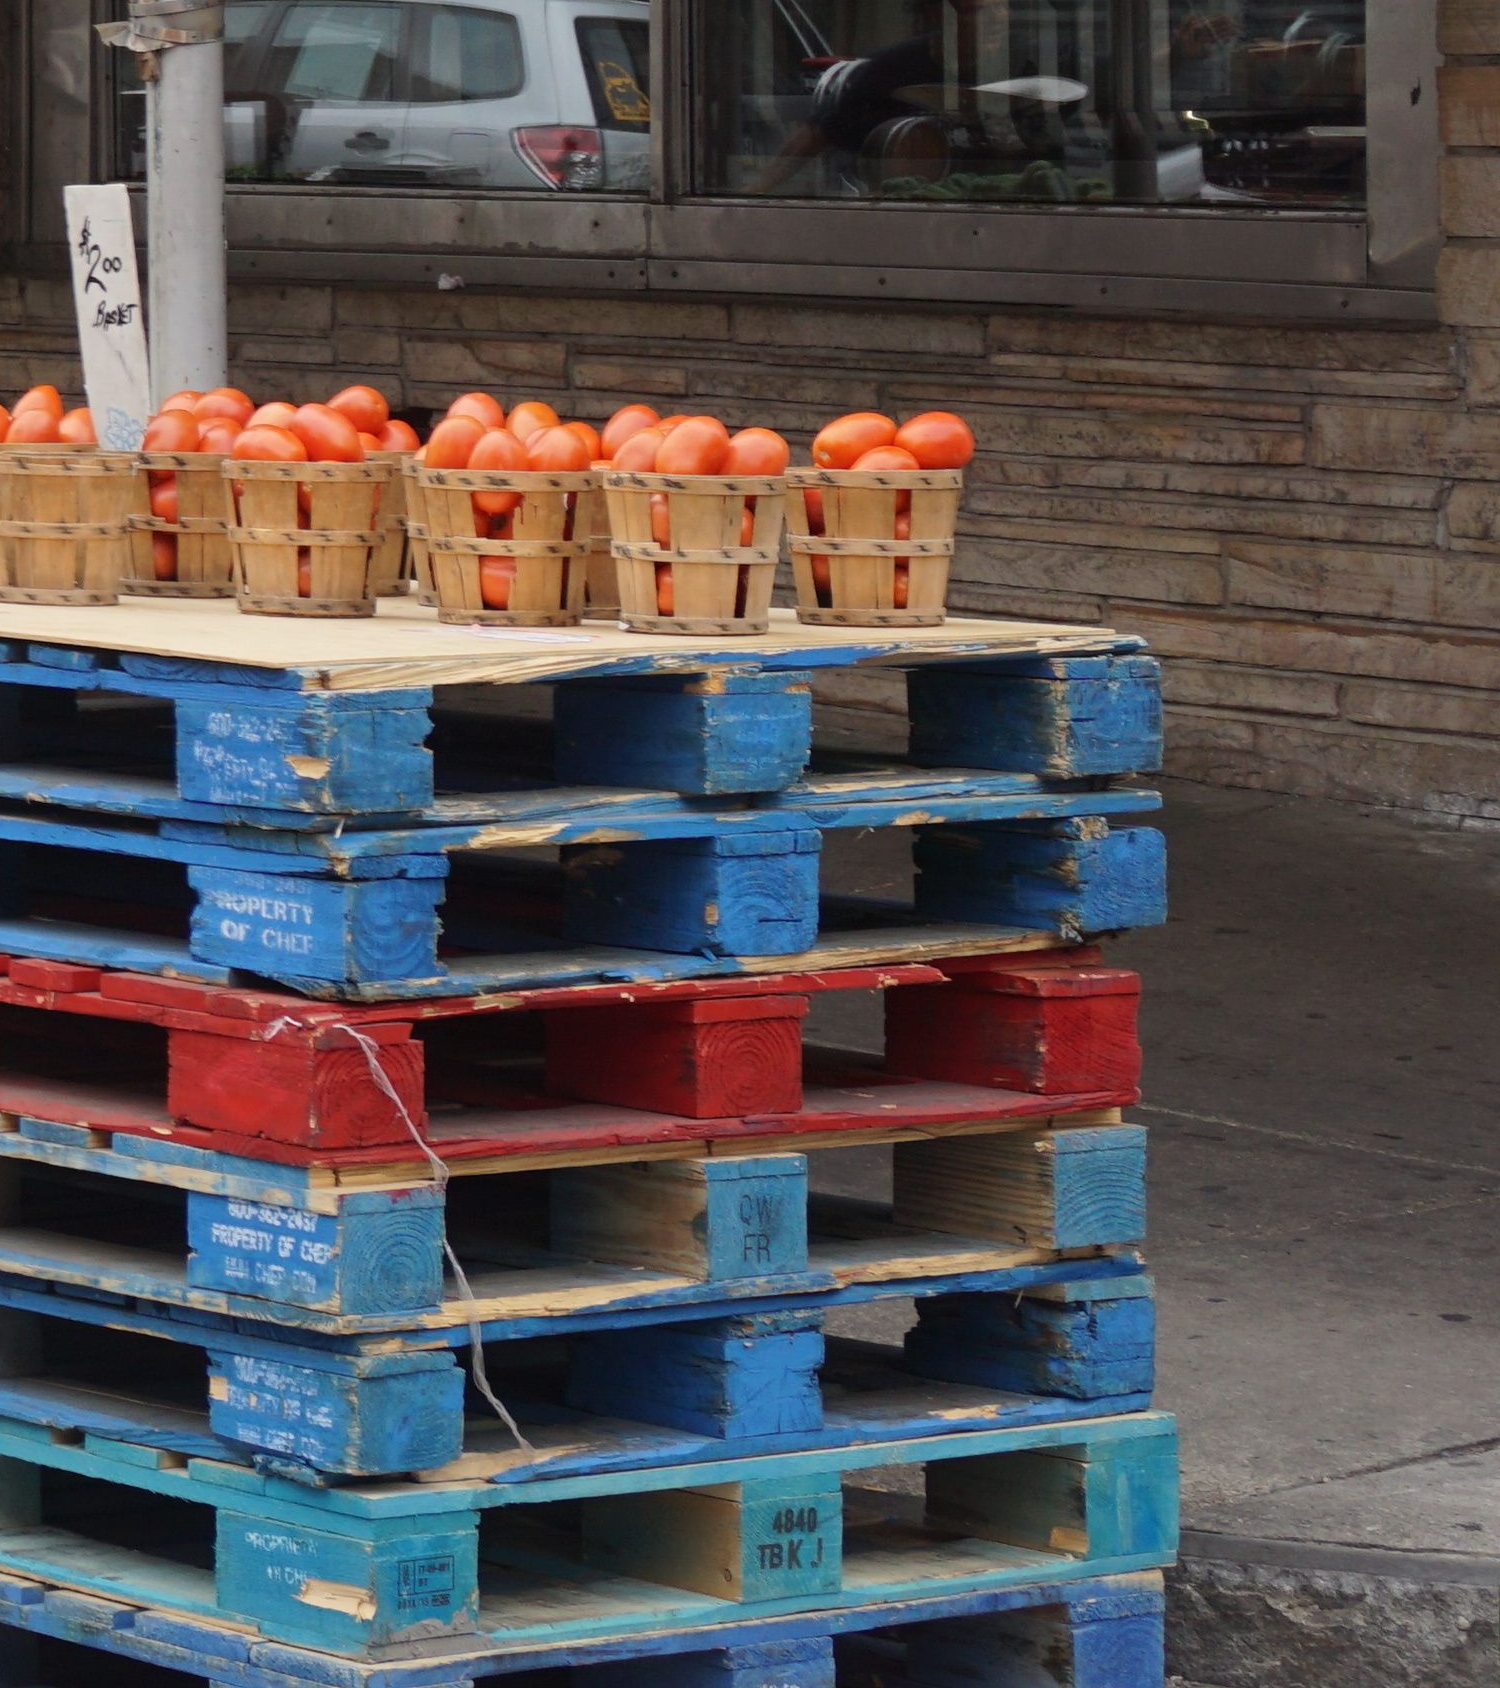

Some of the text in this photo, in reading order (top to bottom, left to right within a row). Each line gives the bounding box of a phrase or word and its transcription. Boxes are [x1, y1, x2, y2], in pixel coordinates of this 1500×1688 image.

[220, 919, 251, 941] OF
[212, 1222, 273, 1253] PROPERTY
[278, 1235, 296, 1258] OF
[772, 1507, 819, 1534] 4840
